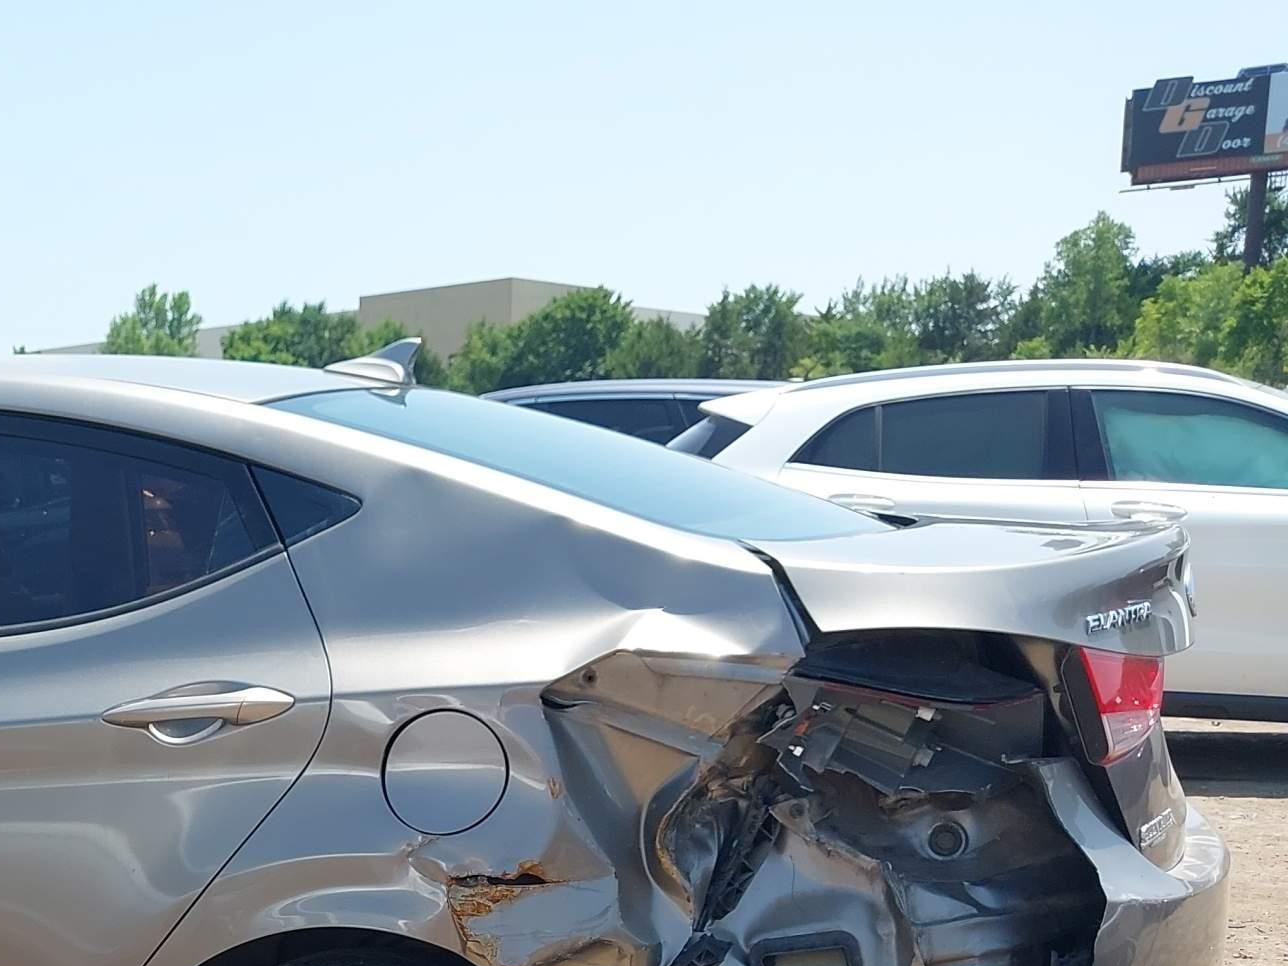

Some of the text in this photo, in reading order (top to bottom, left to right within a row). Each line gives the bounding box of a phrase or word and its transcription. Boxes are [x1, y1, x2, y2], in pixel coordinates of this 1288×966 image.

[1142, 76, 1255, 111] Discount
[1159, 97, 1256, 133] Garage
[1176, 121, 1252, 157] Door
[1086, 601, 1152, 634] ELANTRA
